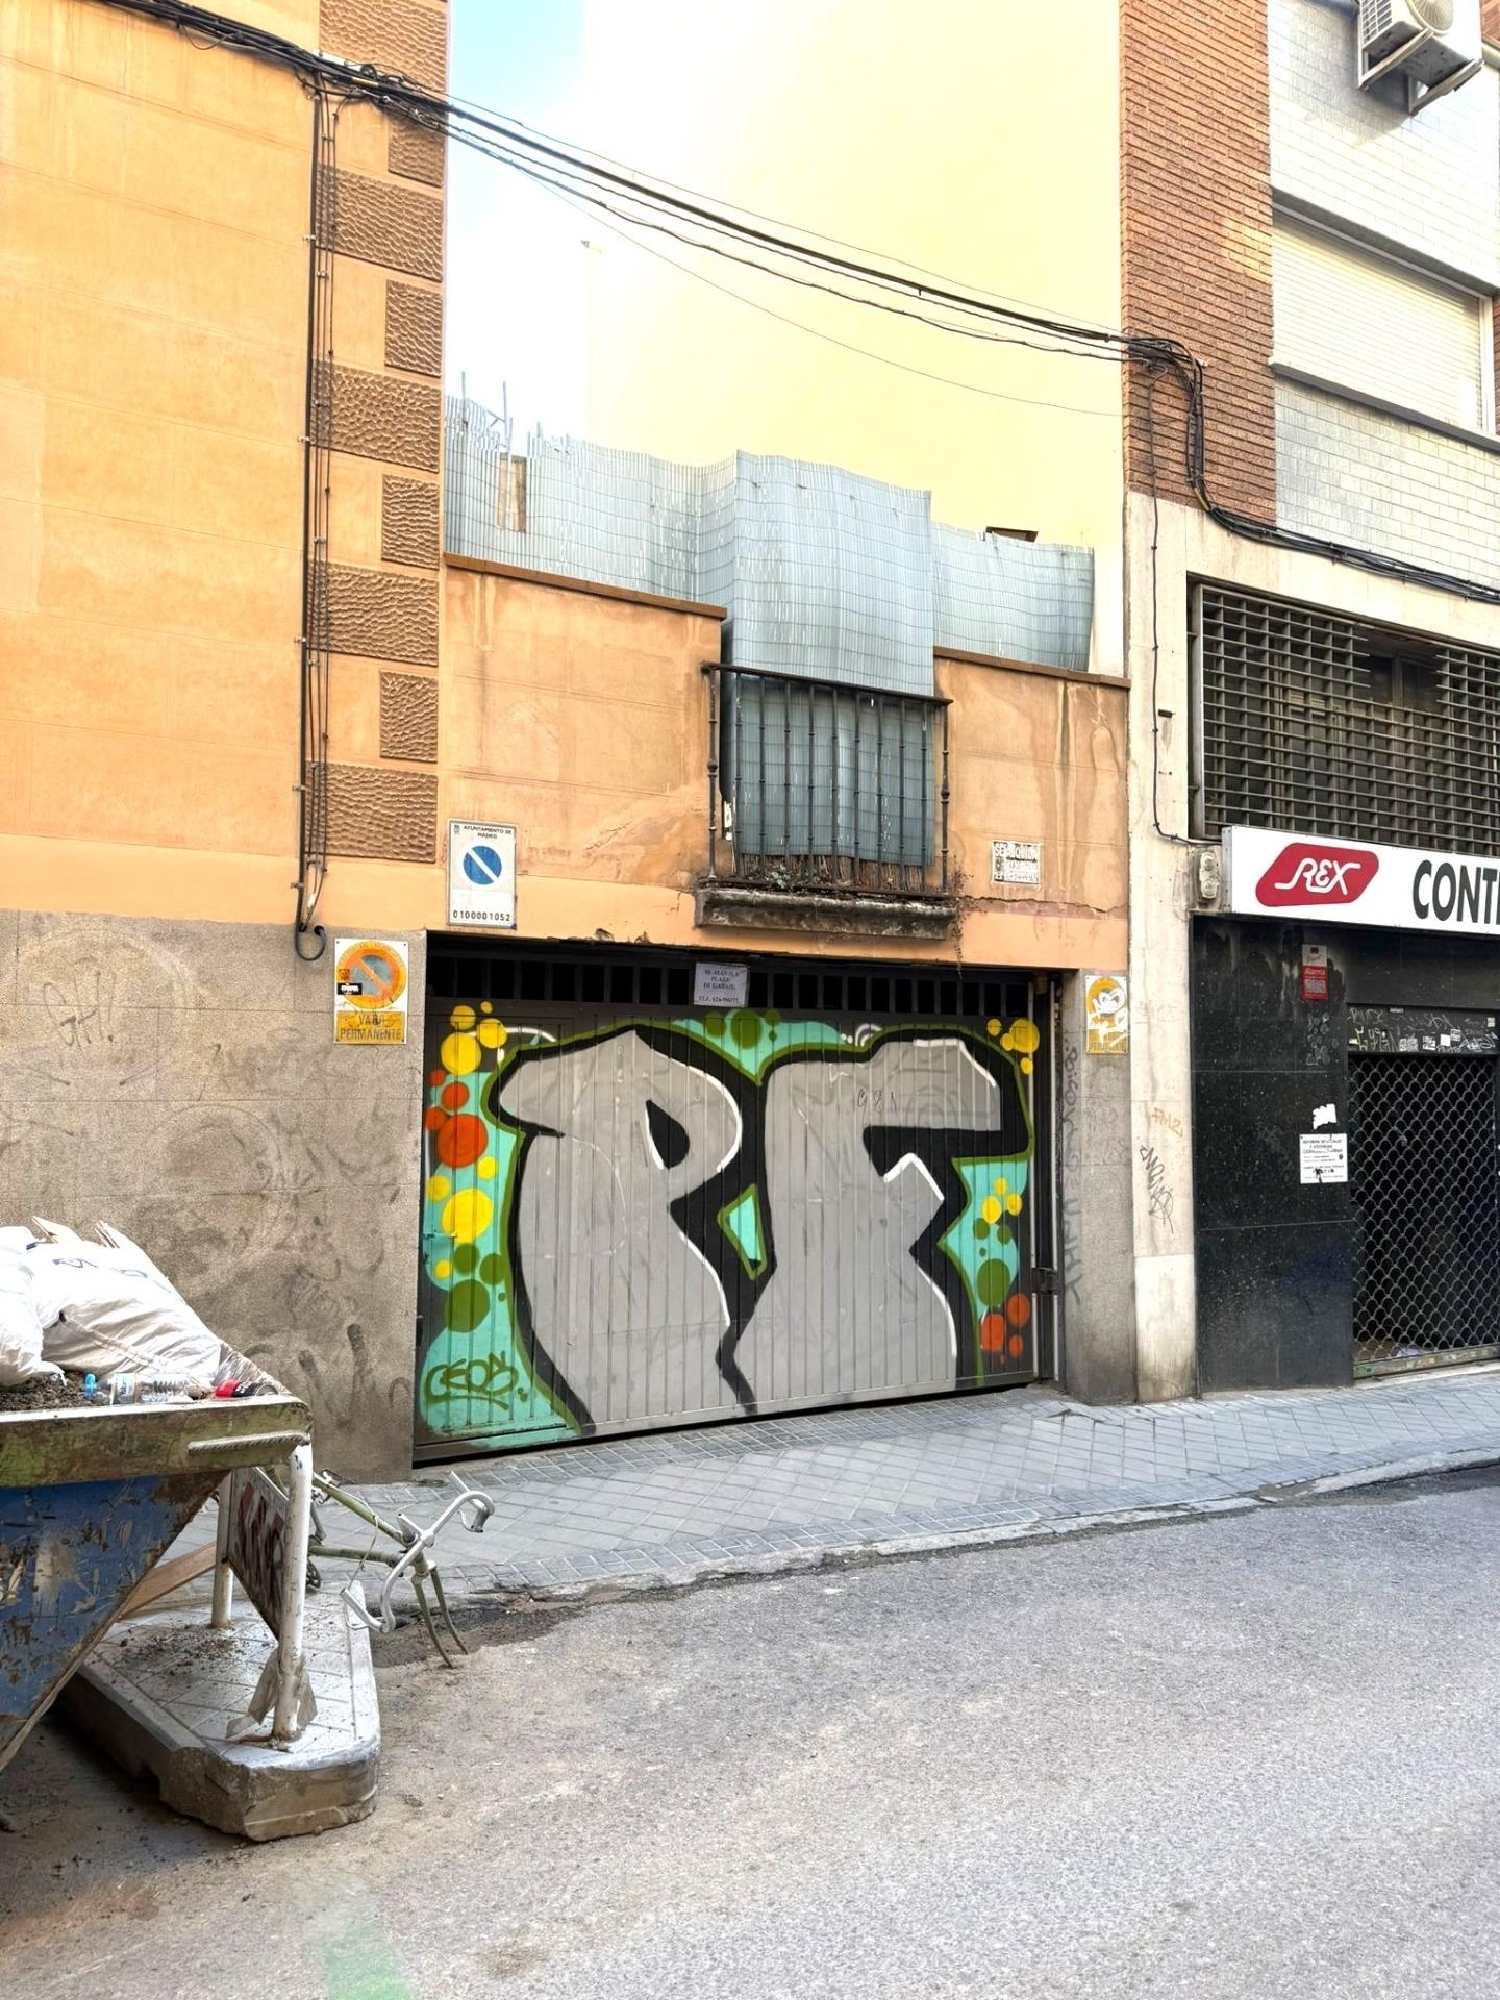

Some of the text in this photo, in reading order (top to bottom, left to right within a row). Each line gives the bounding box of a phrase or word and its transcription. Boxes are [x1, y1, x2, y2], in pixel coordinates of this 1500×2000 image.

[1274, 857, 1361, 895] REX
[1413, 859, 1500, 925] CONT
[340, 1028, 401, 1040] PERMANENTE
